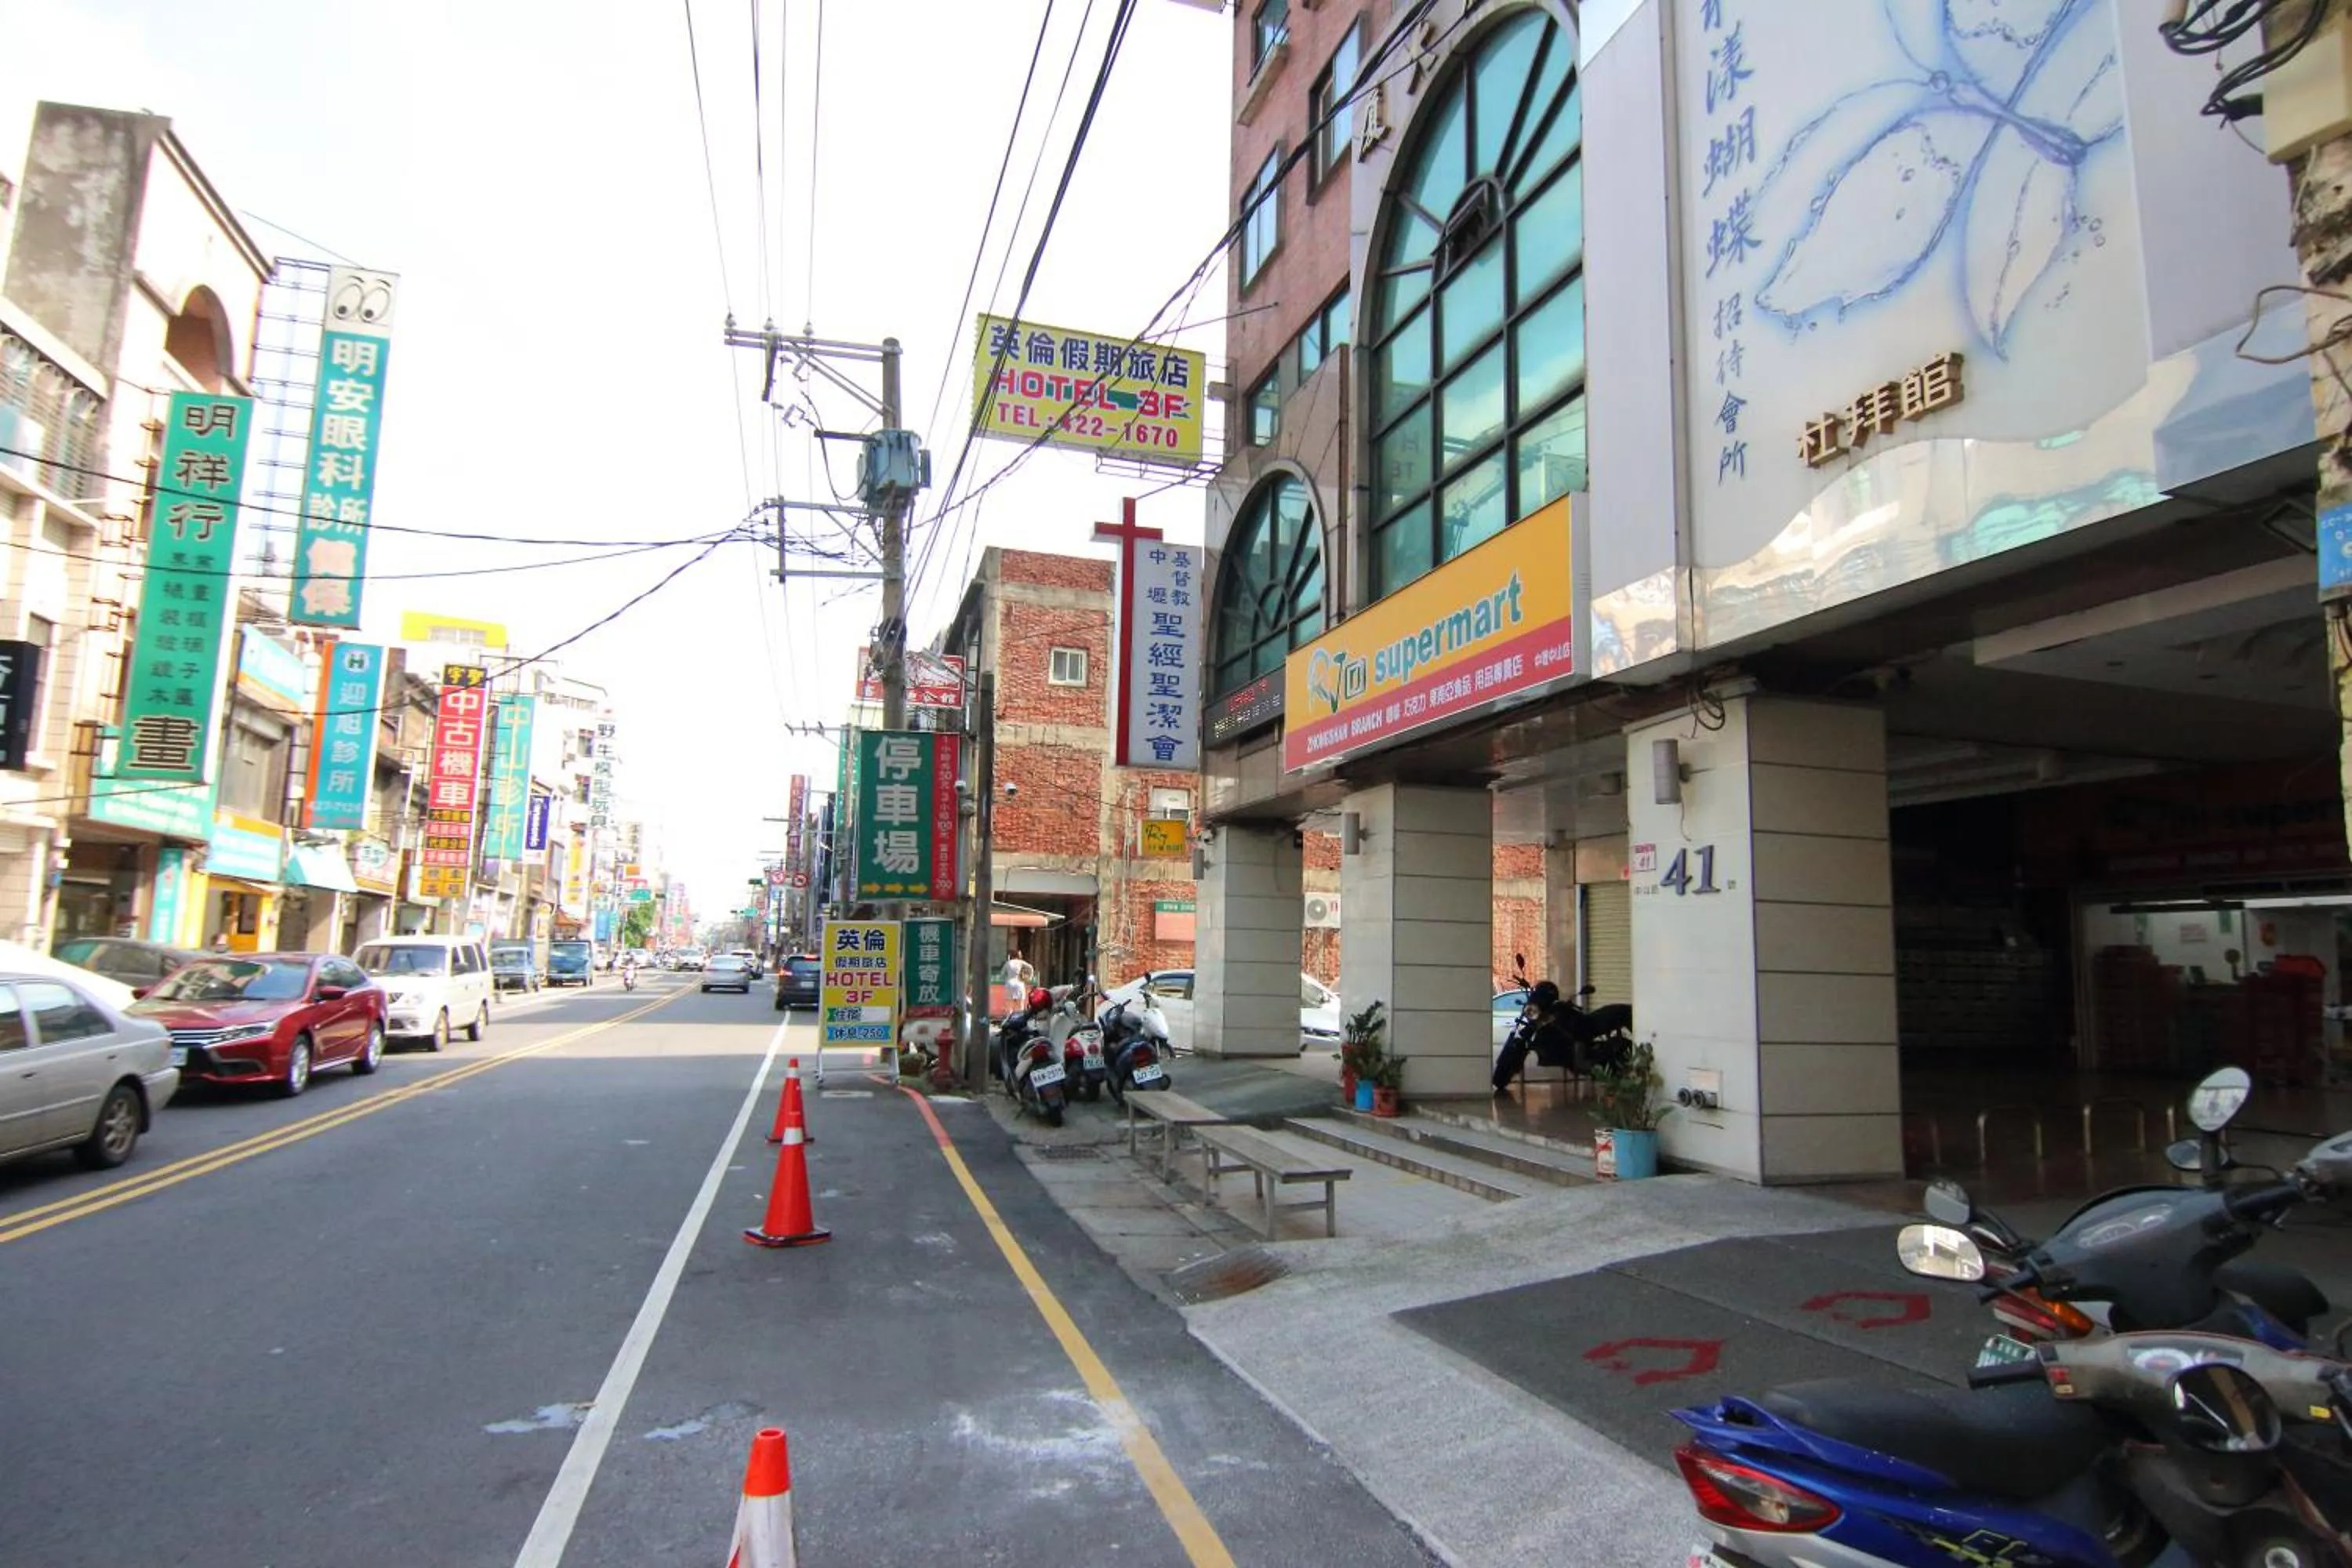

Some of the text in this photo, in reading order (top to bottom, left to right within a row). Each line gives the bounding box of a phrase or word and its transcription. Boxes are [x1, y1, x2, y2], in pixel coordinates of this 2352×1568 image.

[989, 324, 1189, 390] 英倫假期旅店
[995, 368, 1186, 420] HOTEL 3F
[1715, 290, 1748, 487] 招待會所
[317, 338, 379, 492] 明安眼科
[1796, 350, 1965, 470] 杜拜館
[167, 404, 238, 542] 明祥行
[1171, 550, 1192, 607] 基督教
[1374, 570, 1523, 684] supermart
[1145, 612, 1186, 762] 聖經聖潔會
[437, 689, 479, 808] 中古機車
[873, 735, 922, 875] 停車場
[1660, 844, 1722, 897] 41
[825, 971, 894, 986] HOTEL
[835, 956, 887, 969] 假期旅店
[837, 928, 886, 951] 英倫
[918, 924, 941, 1003] 機車寄放
[846, 990, 873, 1004] 3F
